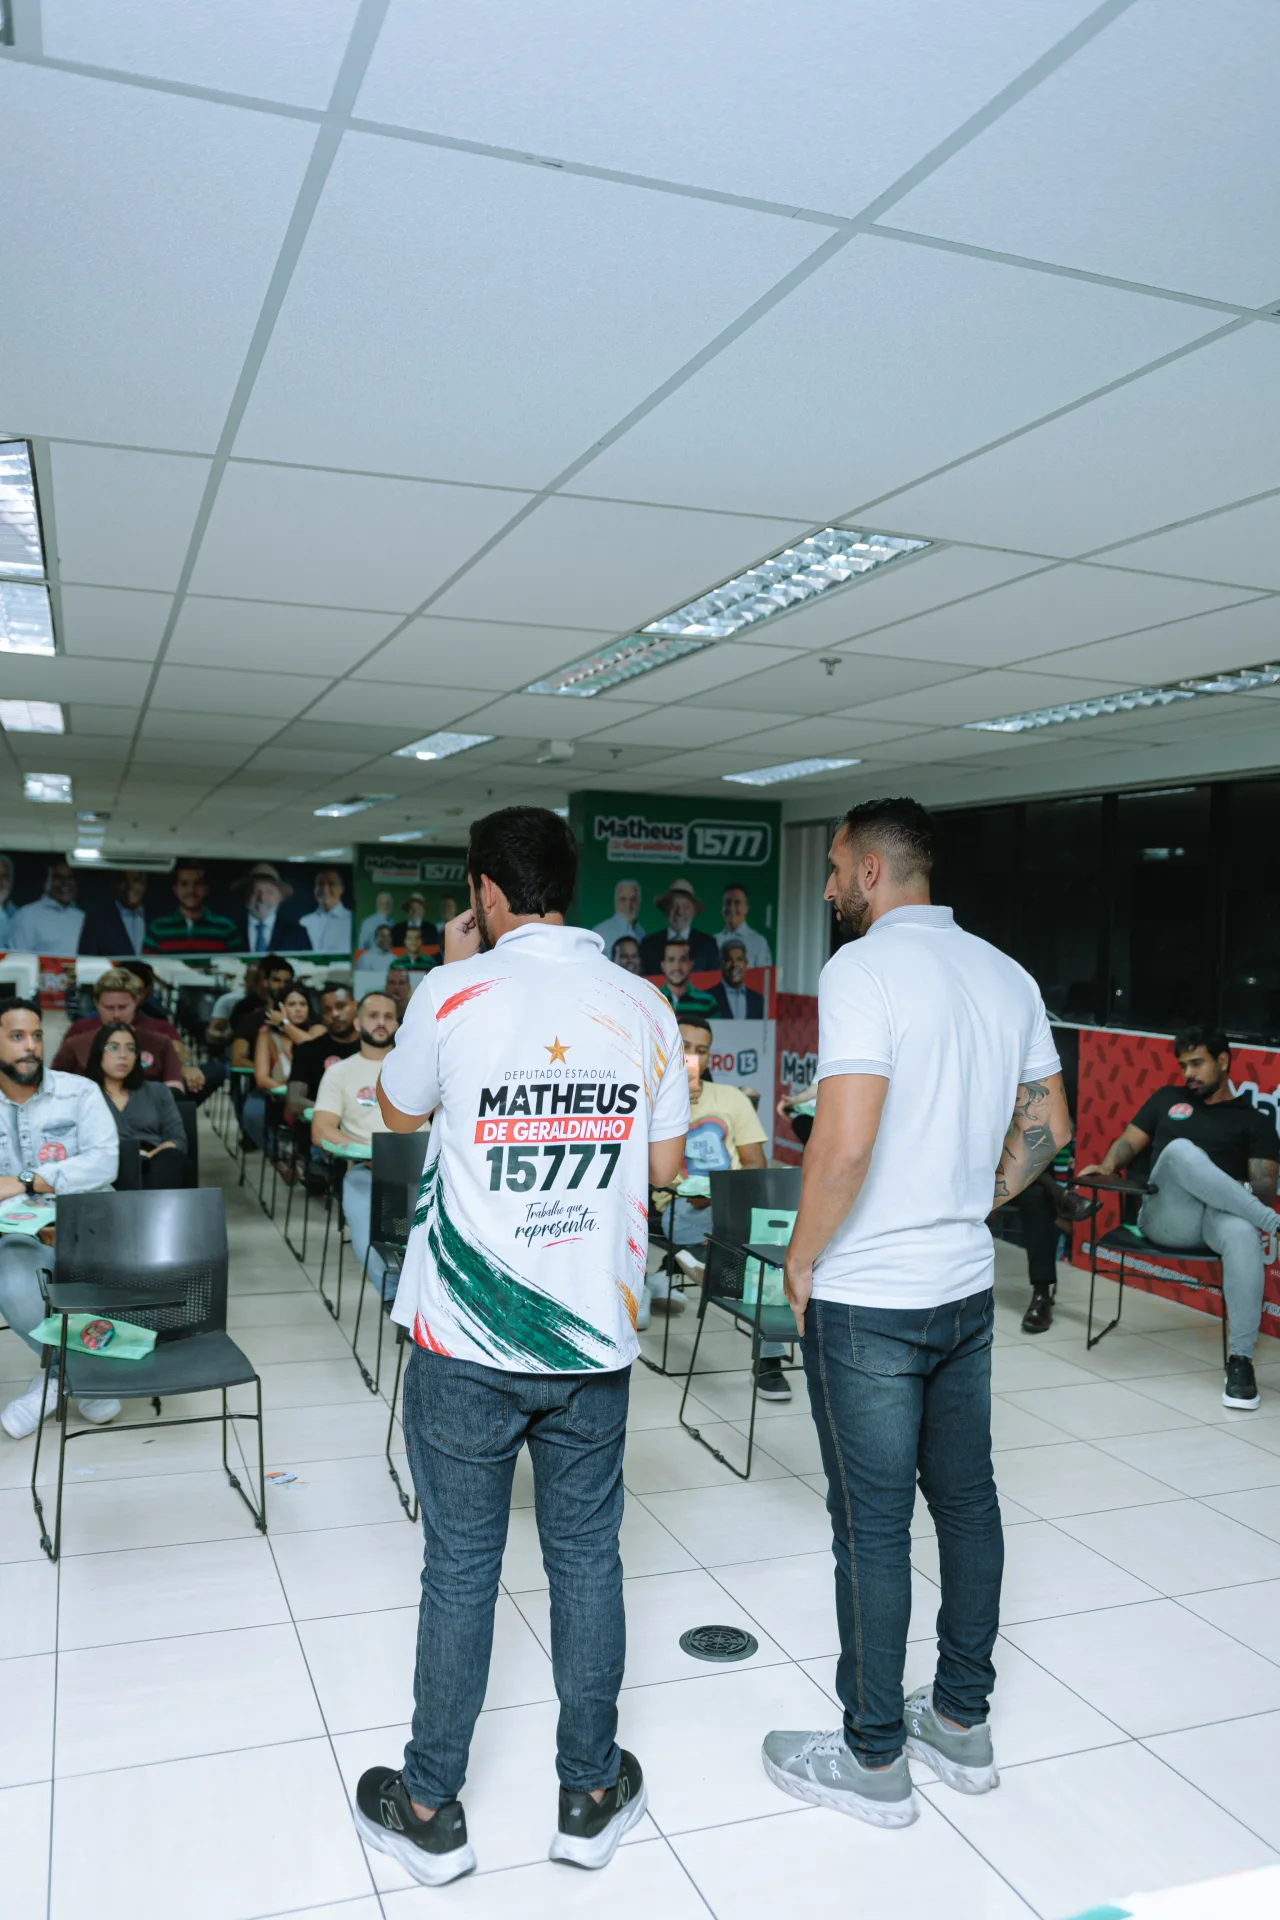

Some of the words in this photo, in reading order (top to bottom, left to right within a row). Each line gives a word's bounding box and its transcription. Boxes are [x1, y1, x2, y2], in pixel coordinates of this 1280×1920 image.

[597, 819, 683, 839] Matheus
[694, 828, 763, 857] 15777
[504, 1069, 562, 1081] DEPUTADO
[565, 1068, 617, 1079] ESTADUAL
[711, 1053, 735, 1071] RO
[783, 1055, 818, 1084] Mat
[478, 1083, 641, 1117] MATHEUS
[482, 1122, 508, 1141] DE
[513, 1119, 626, 1141] GERALDINHO
[486, 1143, 622, 1193] 15777
[525, 1200, 564, 1222] Trabalho
[566, 1202, 584, 1219] que
